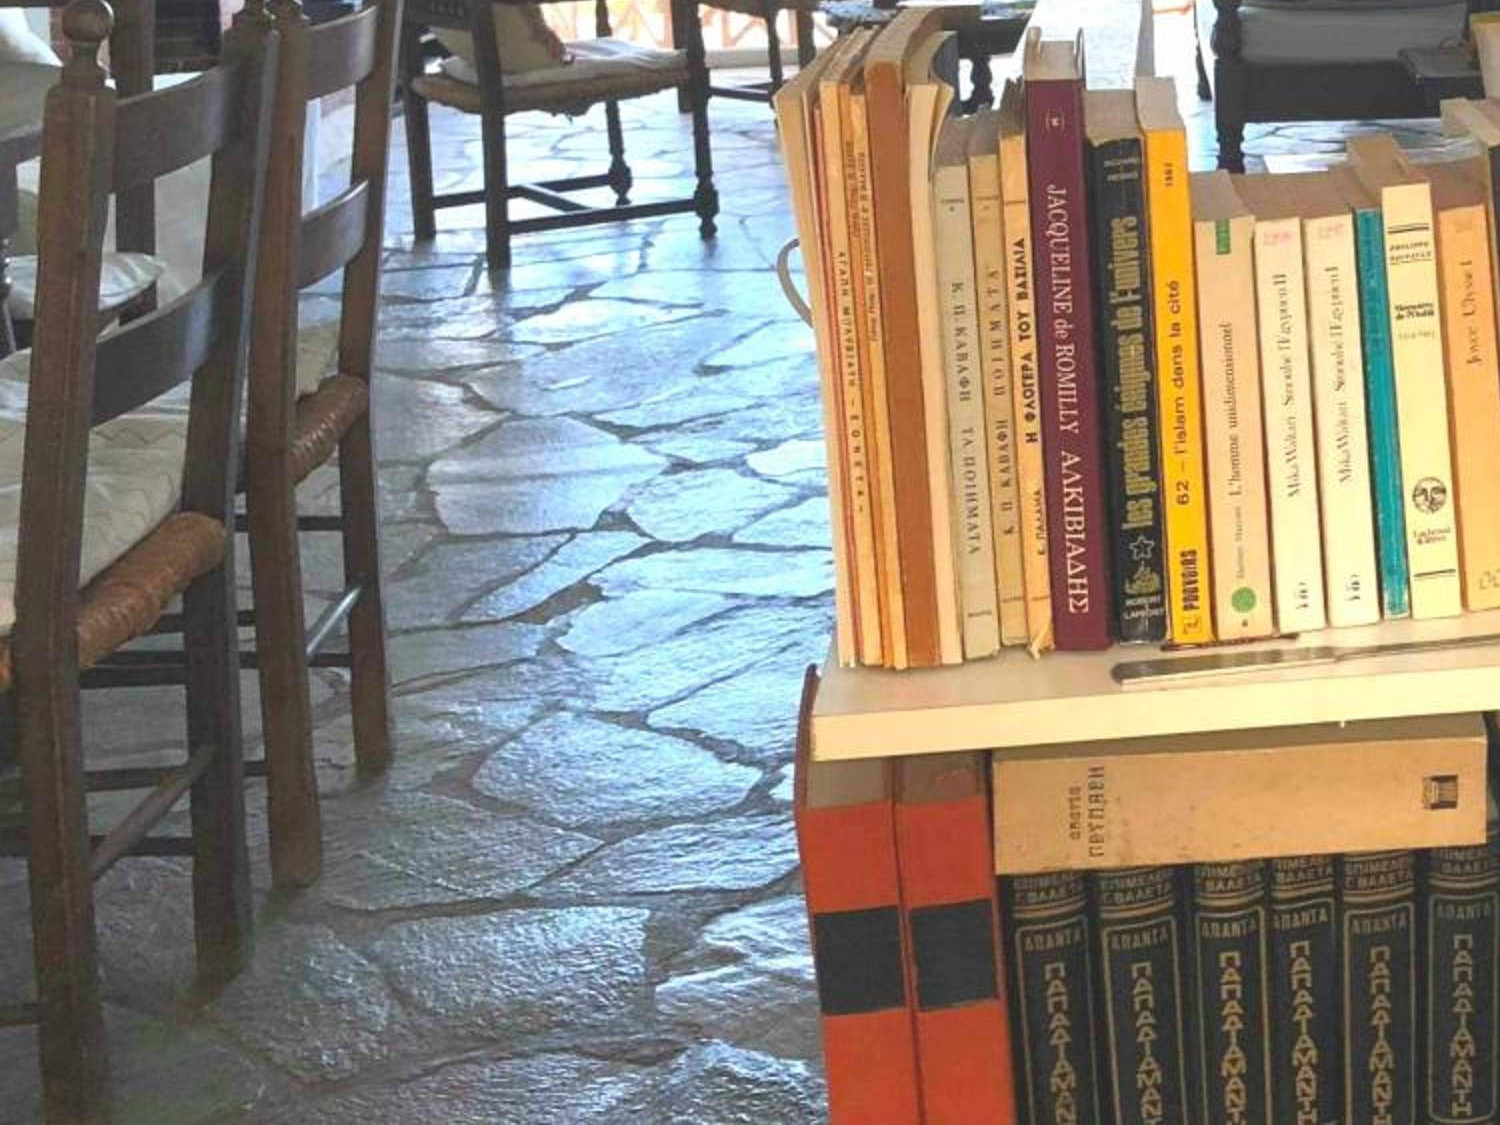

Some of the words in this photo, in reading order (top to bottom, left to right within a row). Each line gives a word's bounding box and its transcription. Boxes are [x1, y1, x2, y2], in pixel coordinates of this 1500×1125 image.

[1013, 237, 1029, 301] ΒΑΣΙΛΙΑ
[1046, 183, 1075, 314] JACQUELINE
[1106, 216, 1143, 303] l'univers
[1016, 312, 1032, 342] ΤΟΥ
[1108, 305, 1145, 331] de
[1165, 280, 1181, 314] cité
[985, 265, 1006, 397] ΠΟΙΗΜΑΤΑ
[1055, 317, 1074, 339] de
[1167, 321, 1181, 338] la
[1017, 350, 1037, 423] ΦΛΟΓΕΡΑ
[1056, 343, 1081, 435] ROMILLY
[1111, 333, 1151, 413] énigmes
[1168, 345, 1184, 388] dans
[951, 325, 972, 403] ΚΑΒΑΦΗ
[962, 454, 982, 556] ΠΟΙΗΜΑΤΑ
[994, 418, 1012, 489] ΚΑΒΑΦΗ
[1023, 431, 1039, 444] Η
[1116, 416, 1158, 493] grandes
[1171, 395, 1188, 456] l'islam
[1121, 498, 1154, 530] les
[1175, 480, 1191, 506] 62
[1060, 451, 1091, 615] ΑΛΚΙΒΙΑΔΗΣ
[1023, 926, 1082, 953] ΑΠΑΝΤΑ
[1110, 925, 1169, 952] ΑΠΑΝΤΑ
[1201, 918, 1259, 943] ΑΠΑΝΤΑ
[1450, 933, 1477, 1117] ΠΑΠΑΔΙΑΜΑΝΤΗ
